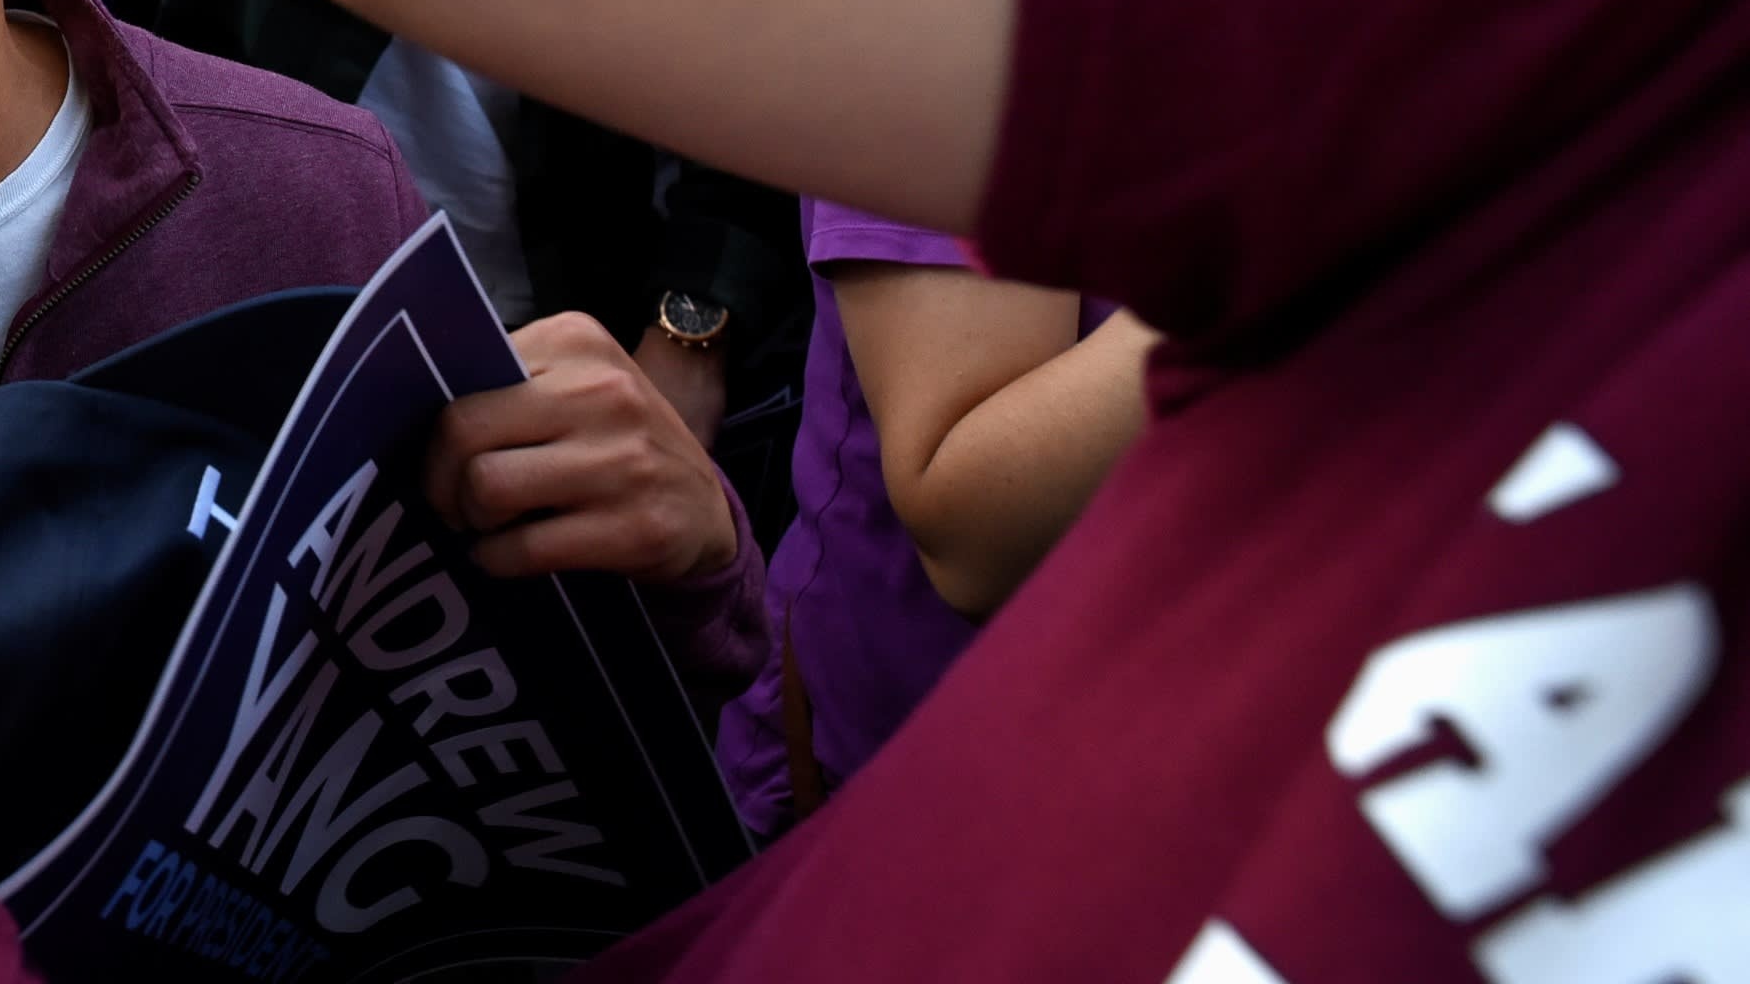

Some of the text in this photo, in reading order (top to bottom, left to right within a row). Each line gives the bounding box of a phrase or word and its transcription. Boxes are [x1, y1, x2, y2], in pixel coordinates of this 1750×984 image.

[183, 581, 490, 934] YANG
[287, 457, 629, 889] ANDREW
[100, 839, 331, 984] FOR PRESIDENT
